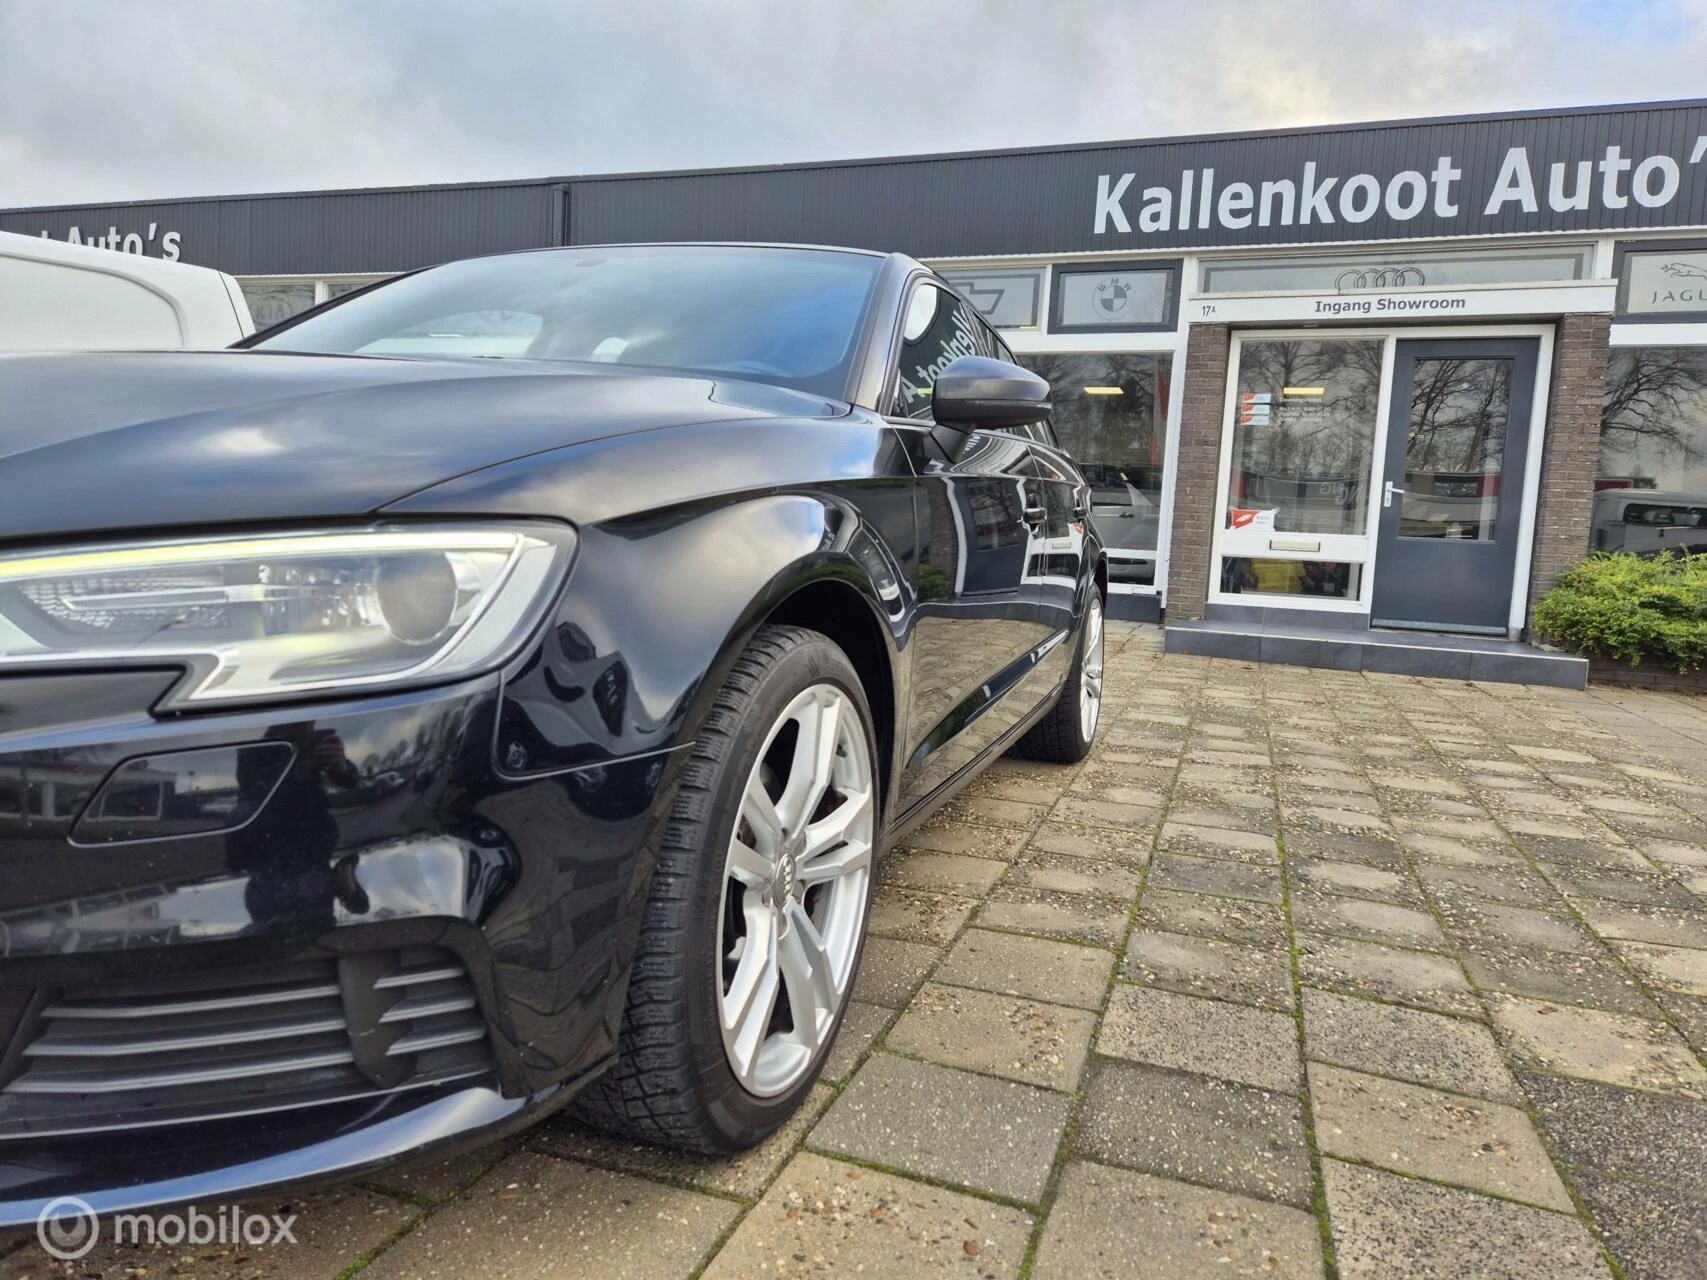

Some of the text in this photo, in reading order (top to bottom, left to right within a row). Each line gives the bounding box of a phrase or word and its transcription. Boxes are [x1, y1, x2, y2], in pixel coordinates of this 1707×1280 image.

[1093, 156, 1461, 235] Kallenkoot
[1315, 298, 1466, 315] Ingang Showroom
